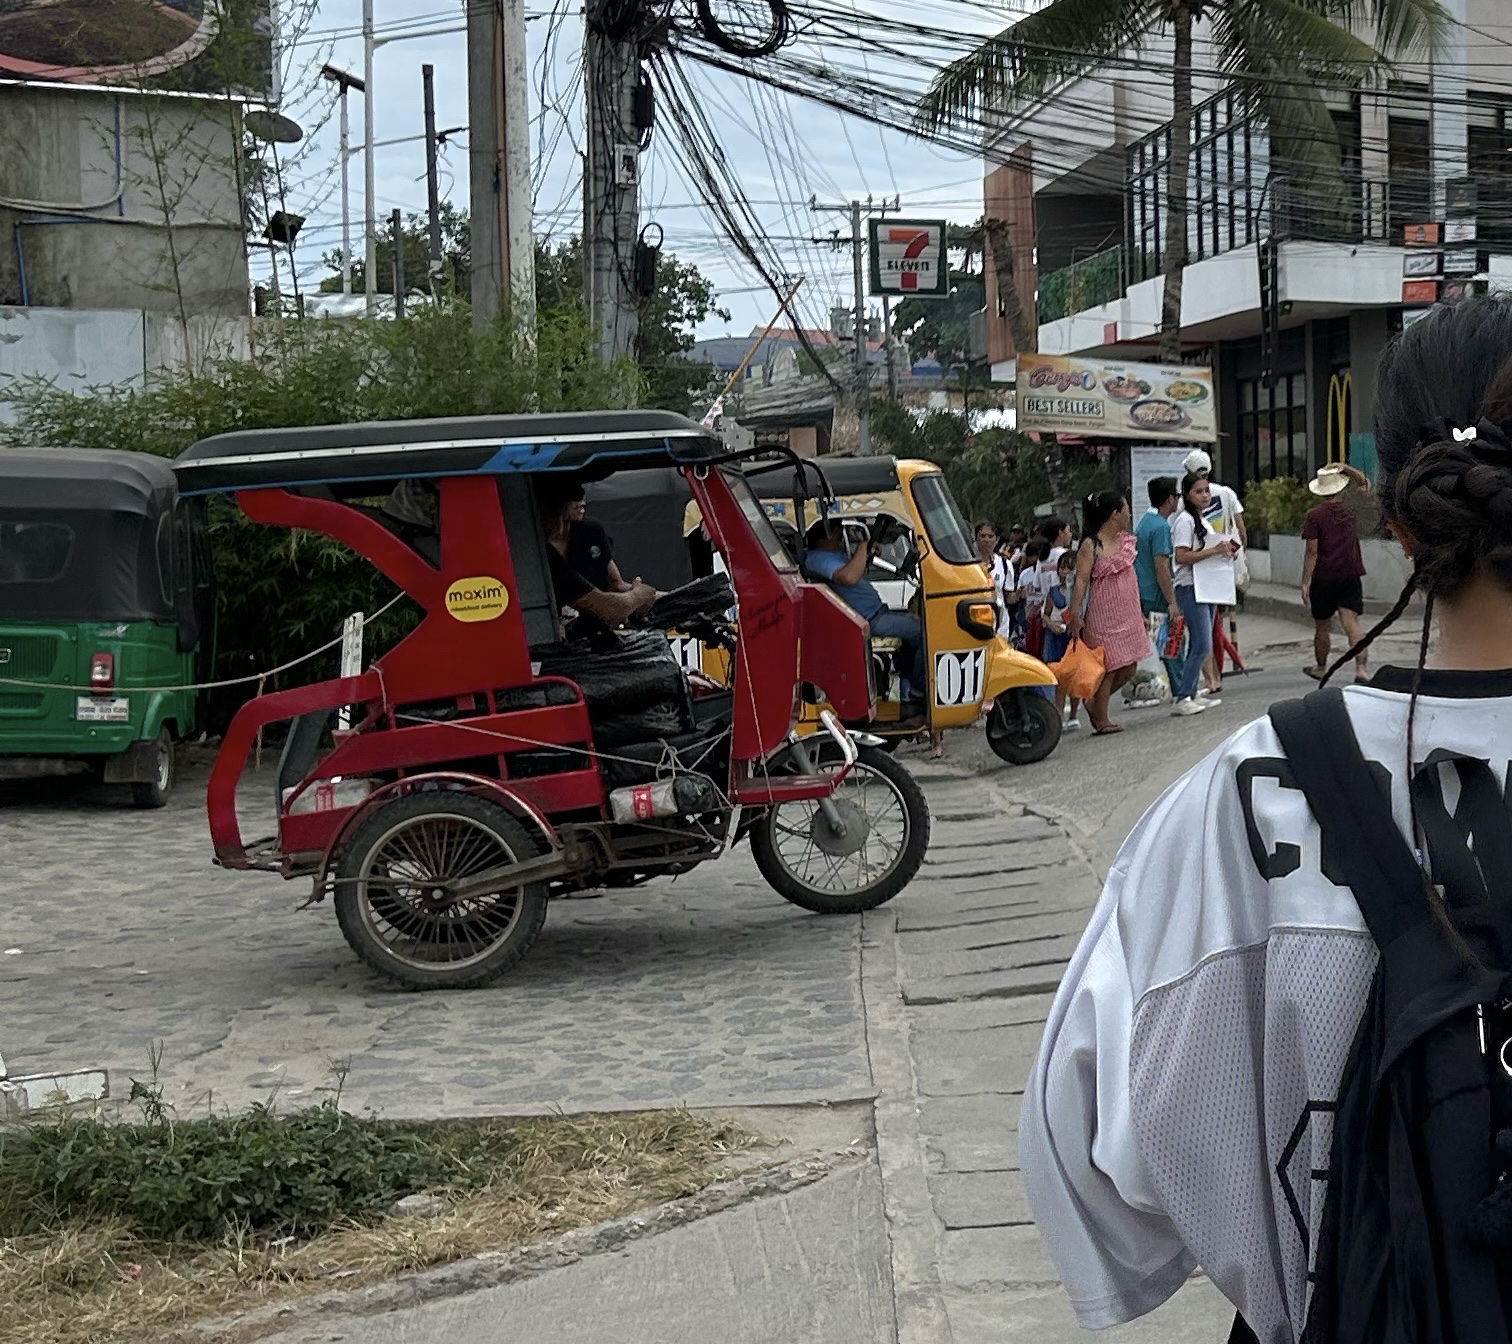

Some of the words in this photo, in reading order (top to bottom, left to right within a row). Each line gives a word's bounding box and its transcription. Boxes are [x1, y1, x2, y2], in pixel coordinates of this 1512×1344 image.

[1027, 398, 1054, 413] BEST
[448, 584, 502, 603] maxim
[937, 649, 986, 705] 011
